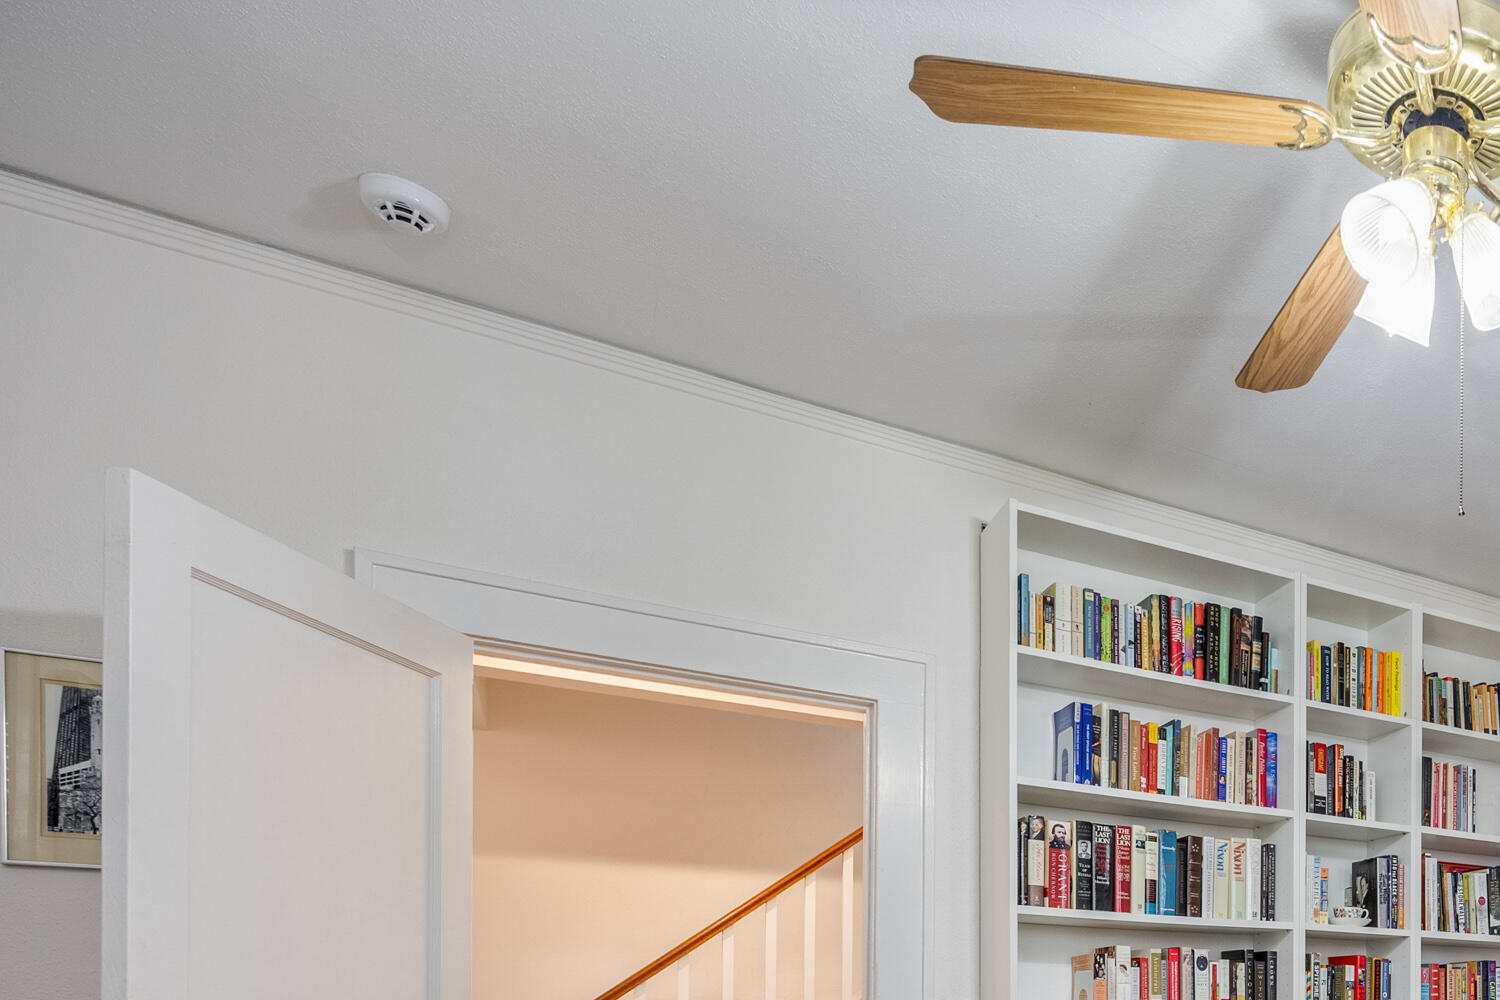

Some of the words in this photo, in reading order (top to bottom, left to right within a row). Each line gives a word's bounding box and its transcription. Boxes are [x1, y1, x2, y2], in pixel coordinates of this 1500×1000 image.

[1171, 618, 1182, 643] RISING
[1216, 842, 1228, 872] Nixon
[1232, 842, 1246, 876] Nixon
[1057, 854, 1068, 901] GRANT
